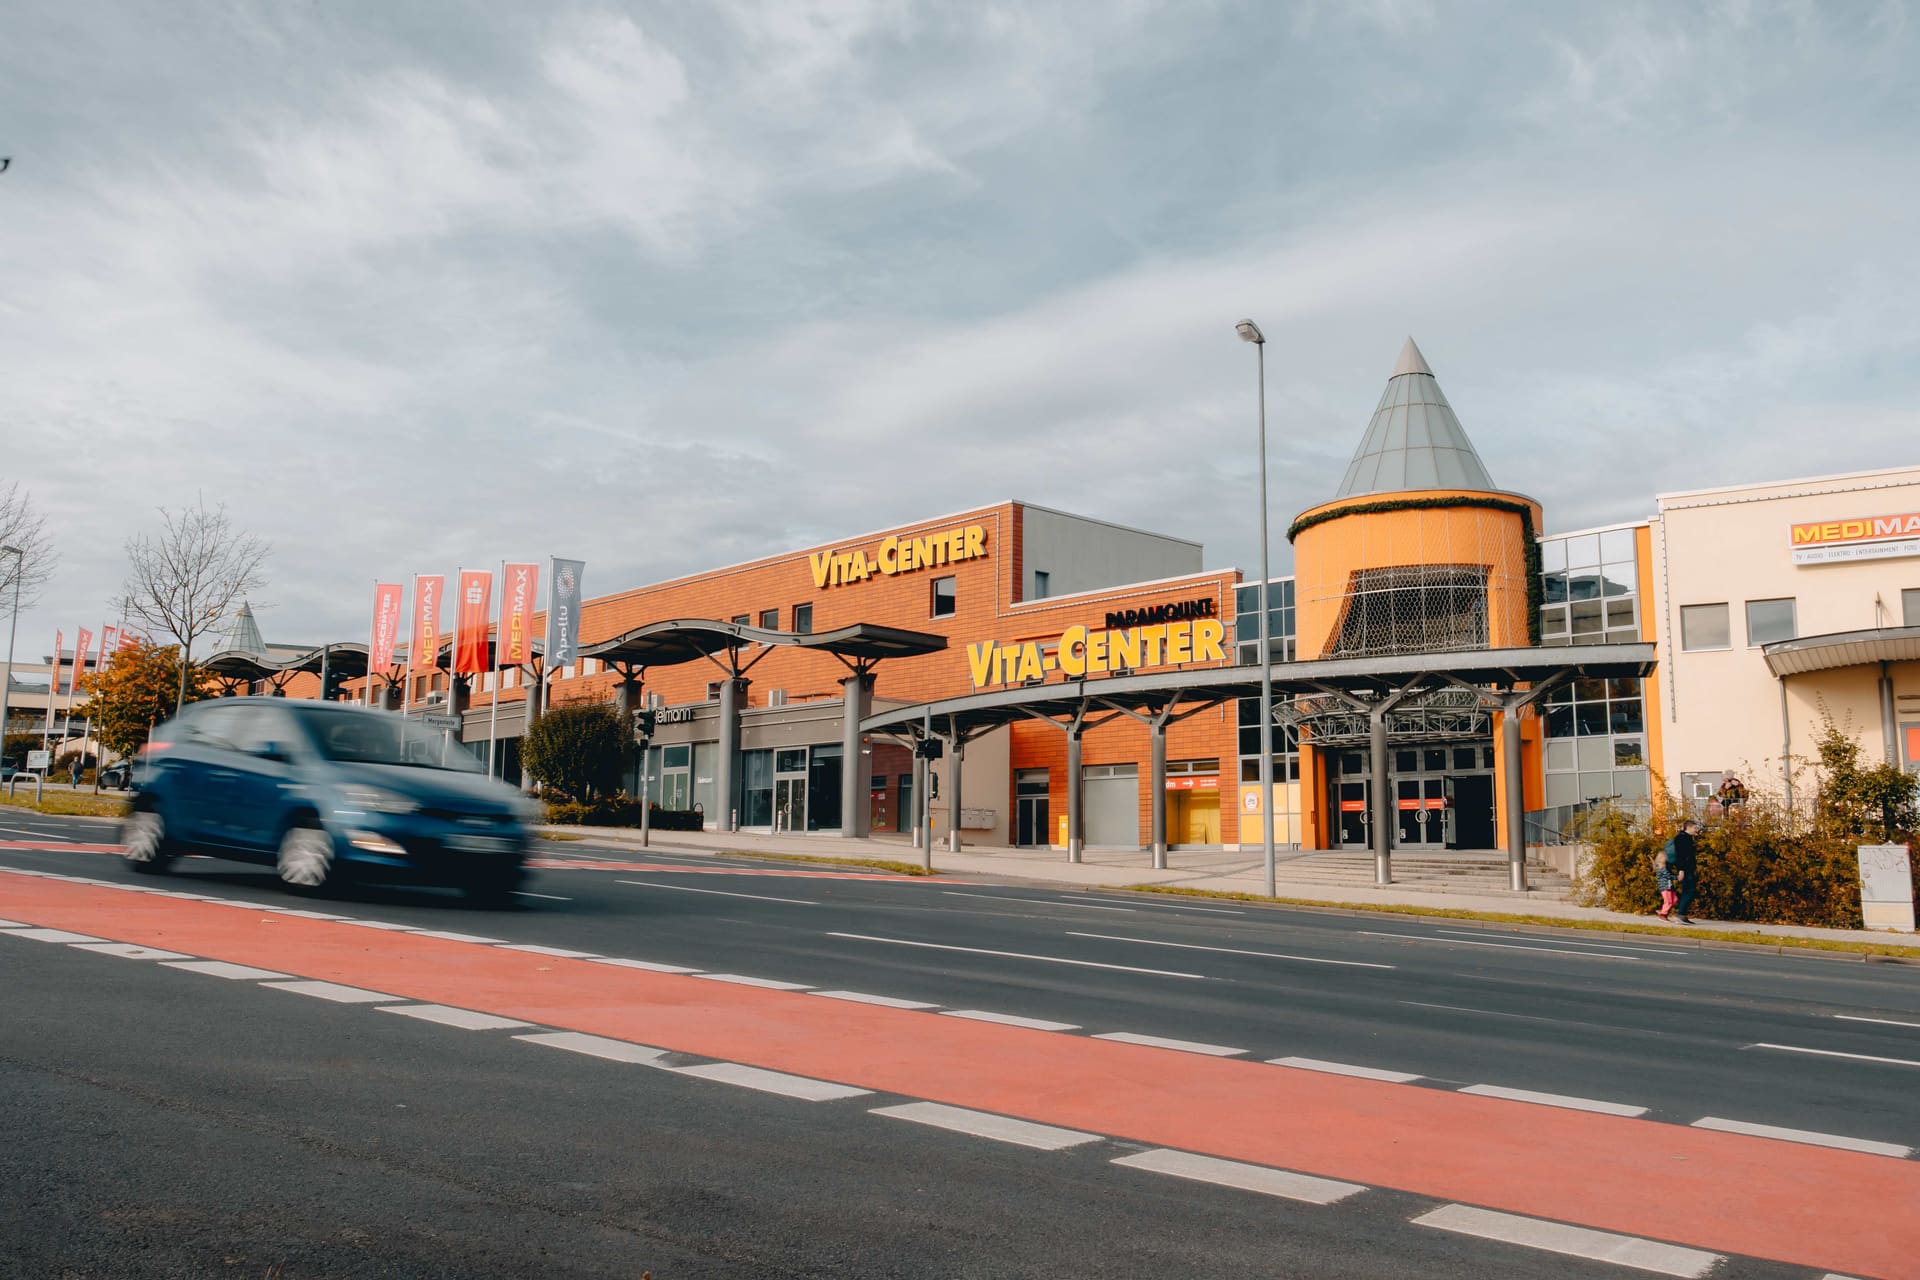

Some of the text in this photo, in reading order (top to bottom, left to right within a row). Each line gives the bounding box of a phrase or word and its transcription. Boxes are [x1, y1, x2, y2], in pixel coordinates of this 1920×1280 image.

[810, 525, 988, 588] VITA-CENTER
[1855, 545, 1900, 557] ENTERTAINMENT
[421, 580, 434, 665] MEDIMAX
[510, 569, 528, 660] MEDIMAX
[1105, 598, 1216, 628] PARAMOUNT
[967, 618, 1227, 688] VITA-CENTER
[655, 706, 691, 724] ielmann
